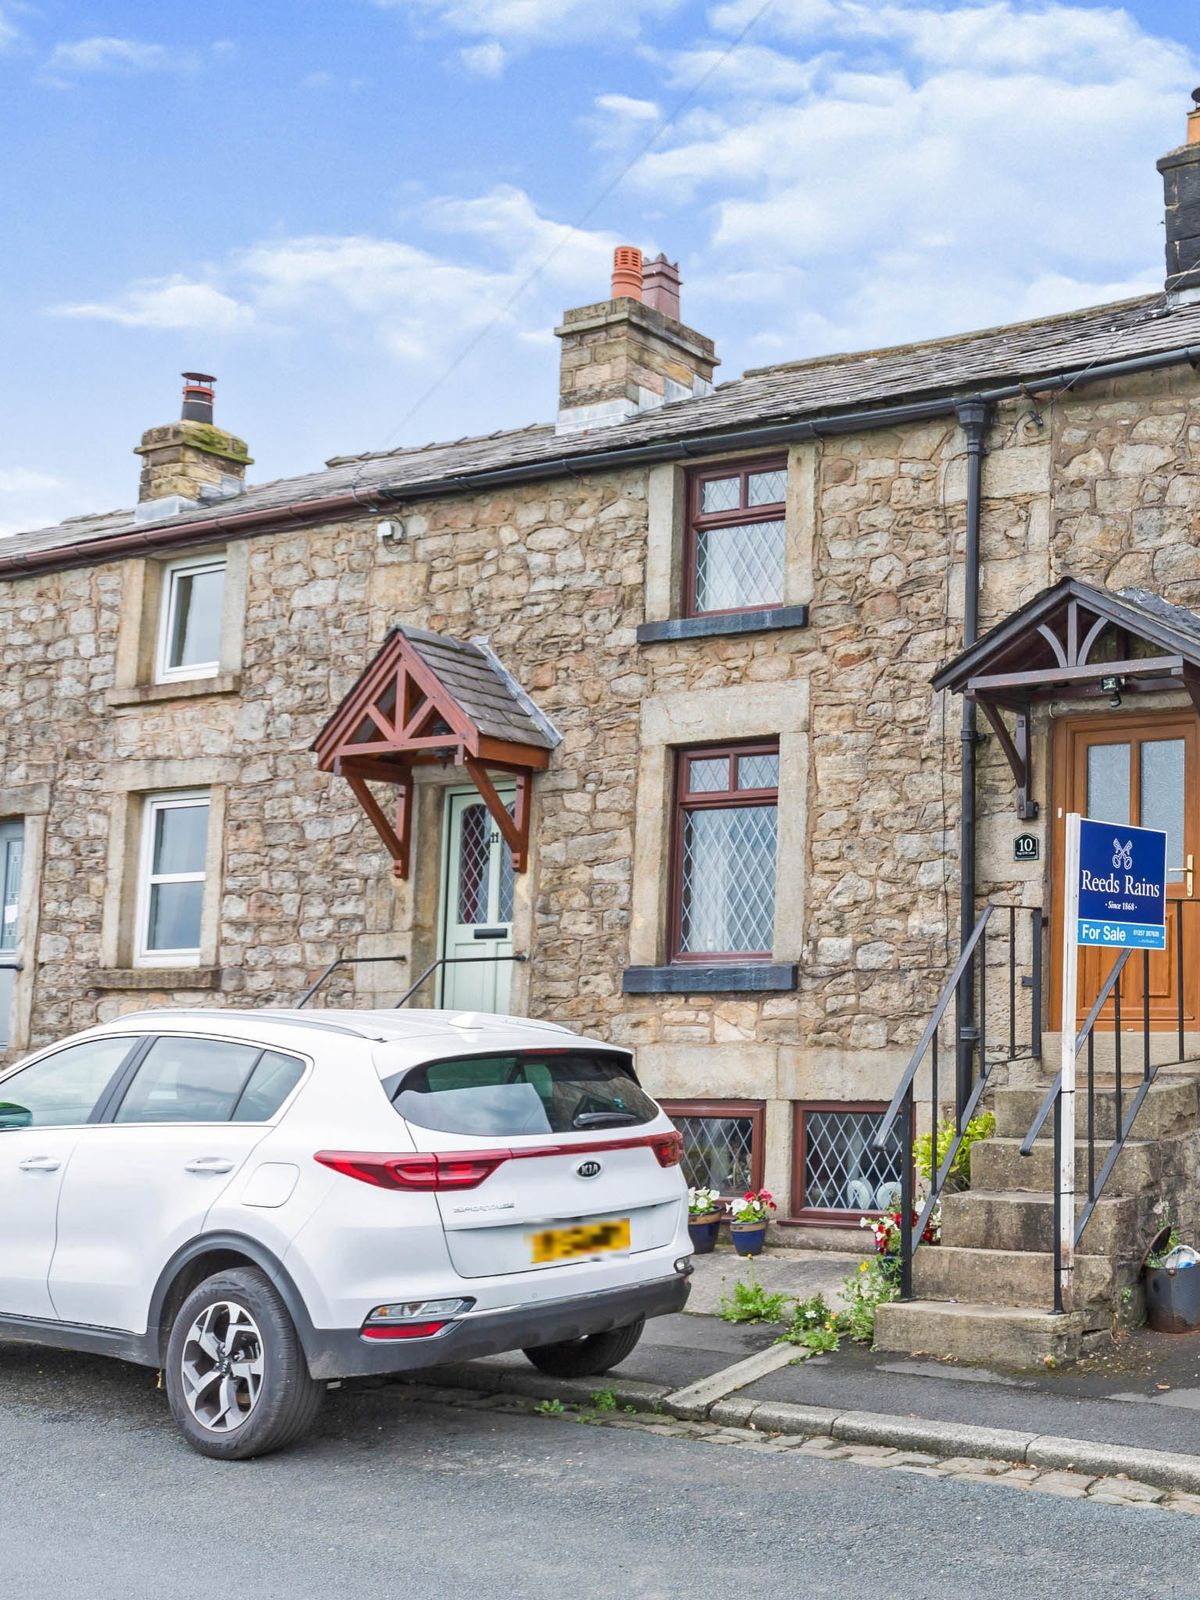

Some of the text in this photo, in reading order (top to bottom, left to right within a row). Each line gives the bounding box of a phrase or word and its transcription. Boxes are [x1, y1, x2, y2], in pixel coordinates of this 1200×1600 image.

[1018, 838, 1033, 852] 10
[1081, 869, 1160, 897] Reeds Rains
[1108, 900, 1135, 911] Since 1868
[1082, 924, 1101, 940] For
[1103, 925, 1126, 942] Sale
[581, 1163, 599, 1175] KIA
